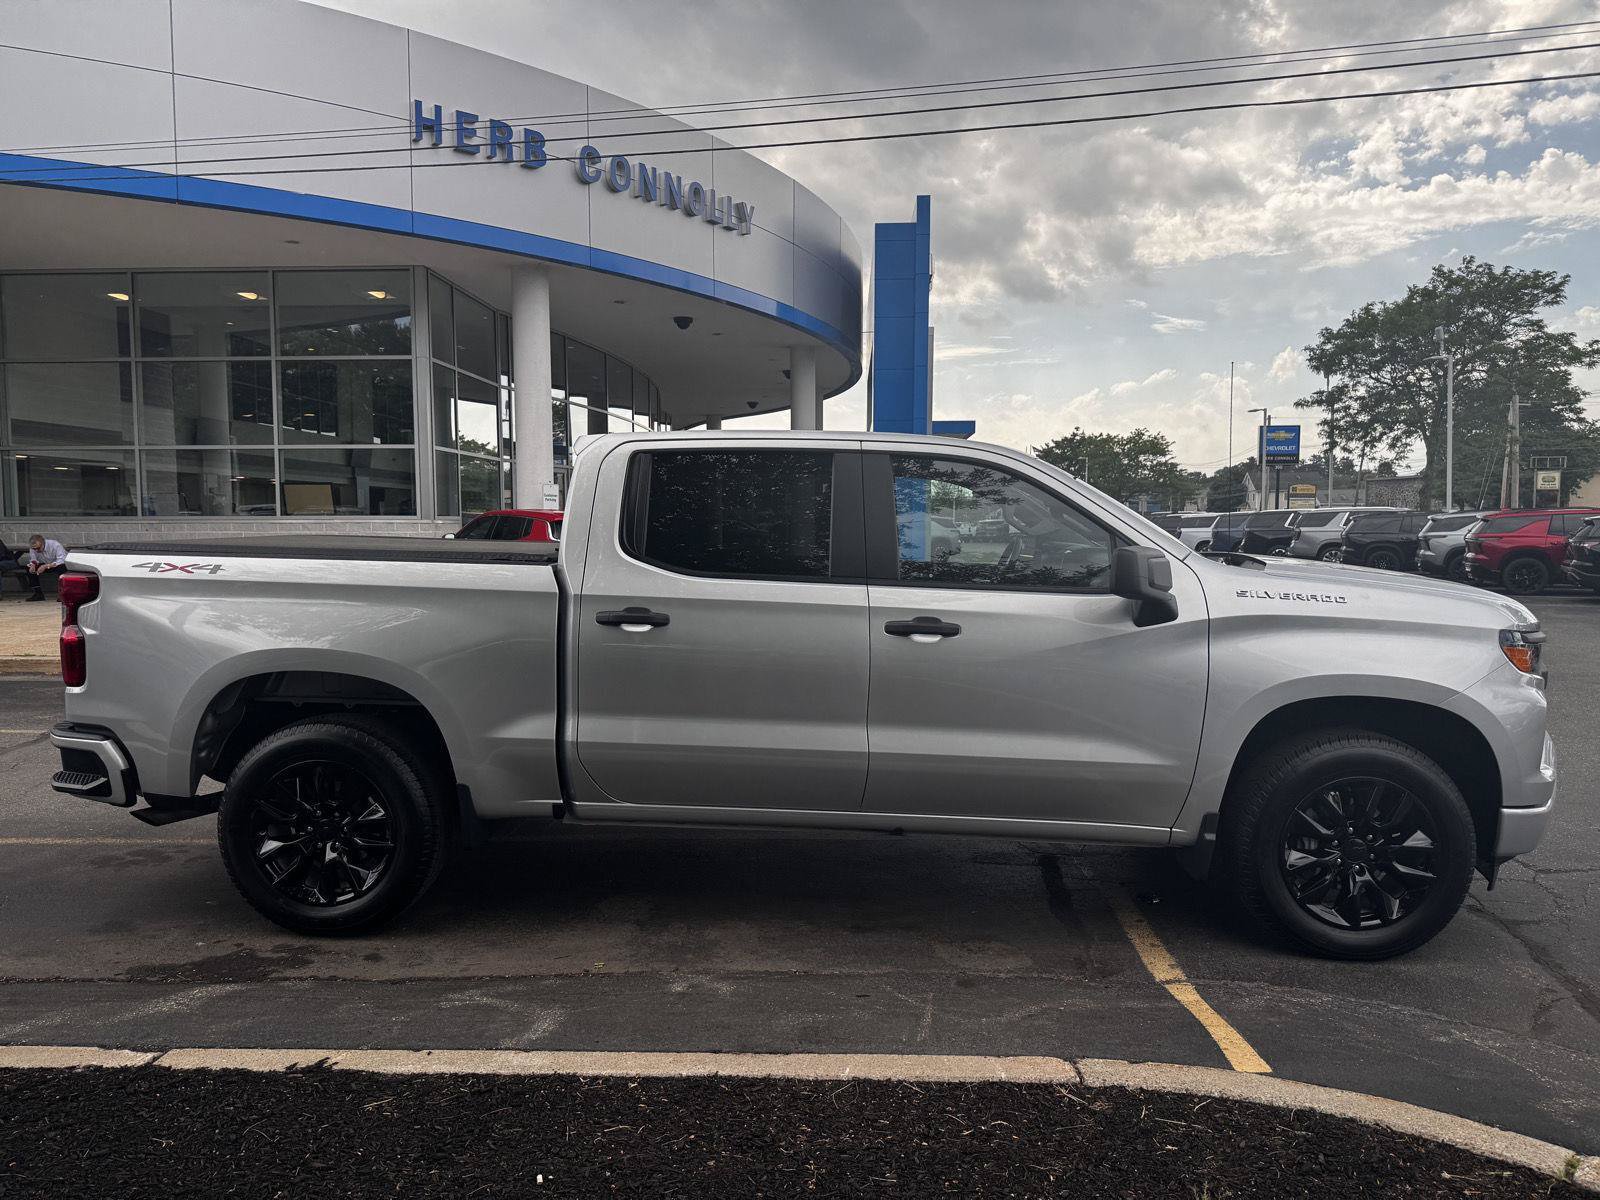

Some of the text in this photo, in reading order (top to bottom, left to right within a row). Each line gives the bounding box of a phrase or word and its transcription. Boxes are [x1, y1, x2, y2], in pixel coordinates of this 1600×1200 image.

[412, 99, 755, 236] HERB CONNOLLY
[1236, 589, 1348, 604] SILVERADO
